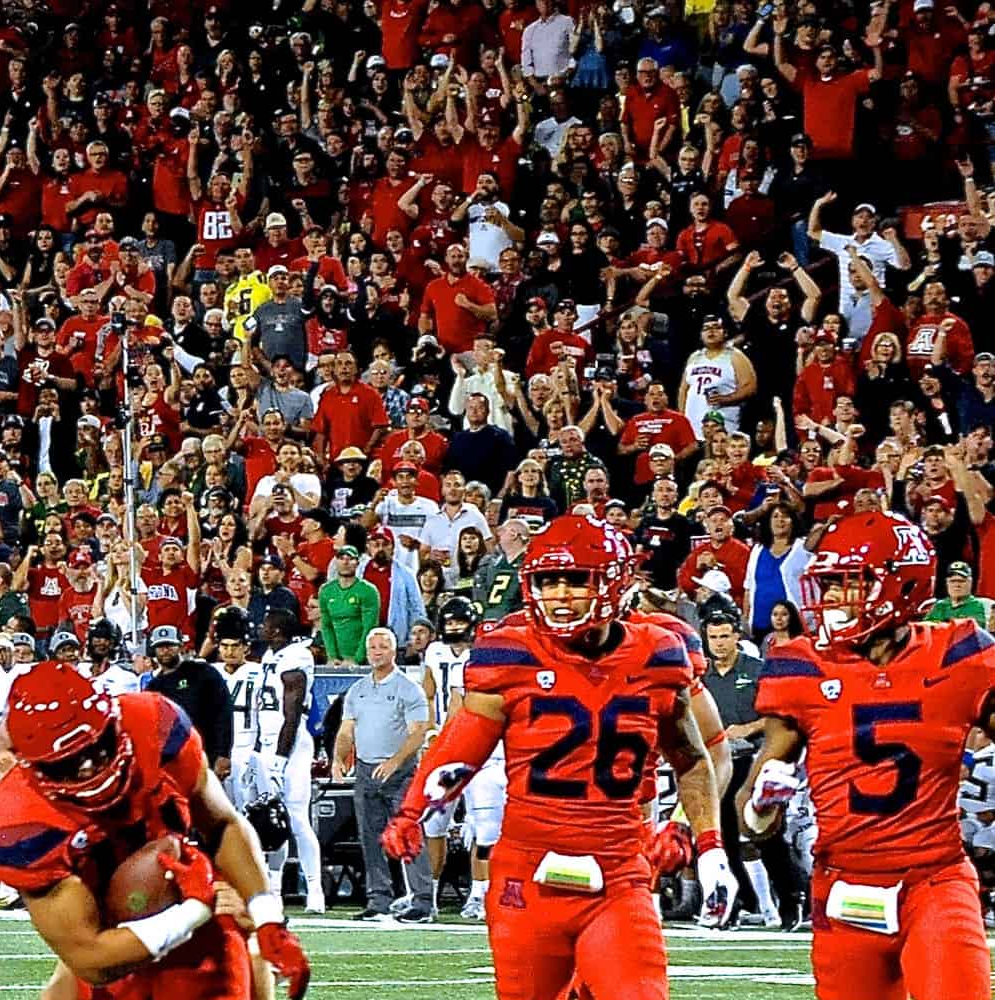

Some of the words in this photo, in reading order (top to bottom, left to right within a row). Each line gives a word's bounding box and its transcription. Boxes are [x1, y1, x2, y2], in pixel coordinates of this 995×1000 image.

[203, 210, 233, 240] 82
[238, 288, 252, 314] 6
[908, 328, 937, 356] A
[893, 523, 931, 566] A
[40, 575, 62, 596] A
[488, 574, 510, 604] 2
[528, 695, 651, 799] 26
[848, 703, 923, 815] 5
